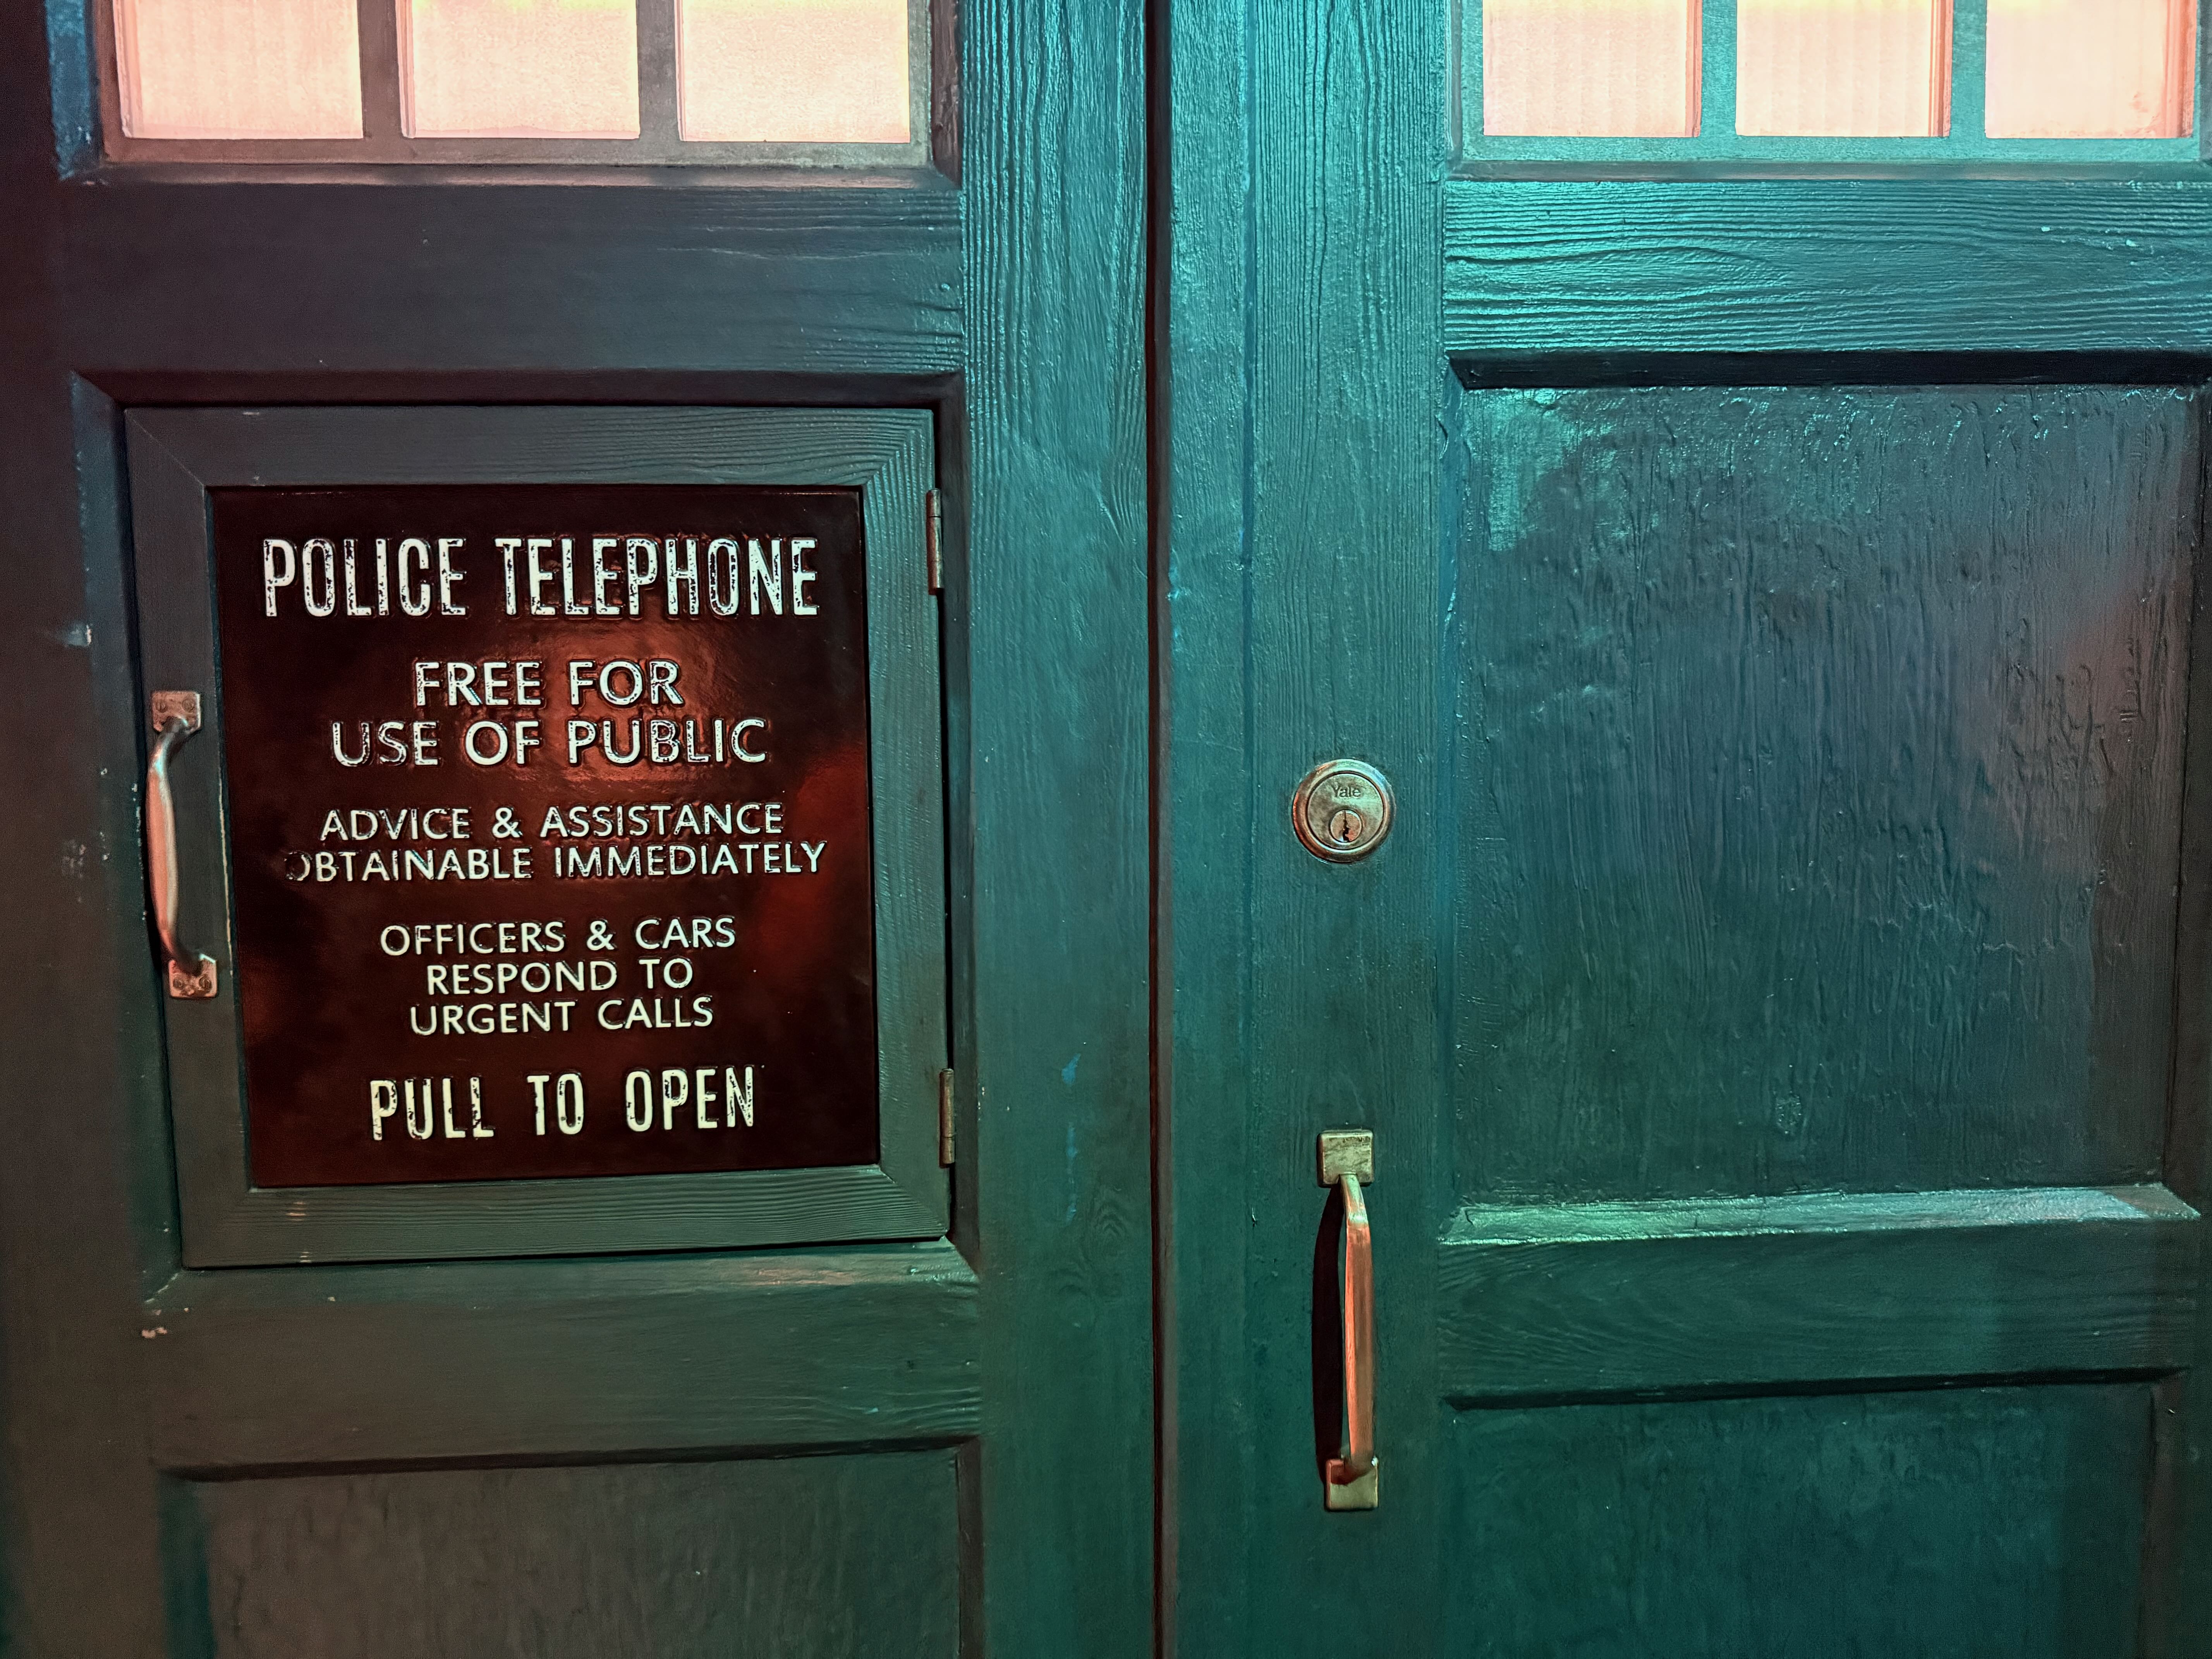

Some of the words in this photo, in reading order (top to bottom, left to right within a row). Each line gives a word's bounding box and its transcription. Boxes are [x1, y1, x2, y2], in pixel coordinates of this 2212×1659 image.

[264, 539, 465, 616] POLICE
[495, 539, 817, 615] TELEPHONE
[416, 662, 541, 705] FREE
[570, 661, 683, 705] FOR
[333, 721, 438, 766] USE
[466, 721, 539, 765] OF
[568, 719, 765, 763] PUBLIC
[1332, 784, 1362, 798] Yale
[321, 809, 469, 840] ADVICE
[493, 807, 519, 838] &
[540, 804, 781, 837] ASSISTANCE
[555, 843, 824, 876] IMMEDIATELY
[381, 922, 564, 955] OFFICERS
[587, 921, 614, 950] &
[636, 918, 735, 948] CARS
[428, 961, 617, 994] RESPOND
[639, 958, 692, 988] TO
[411, 1001, 575, 1035] URGENT
[598, 997, 712, 1029] CALLS
[371, 1077, 493, 1140] PULL
[527, 1074, 584, 1135] TO
[626, 1067, 753, 1131] OPEN
